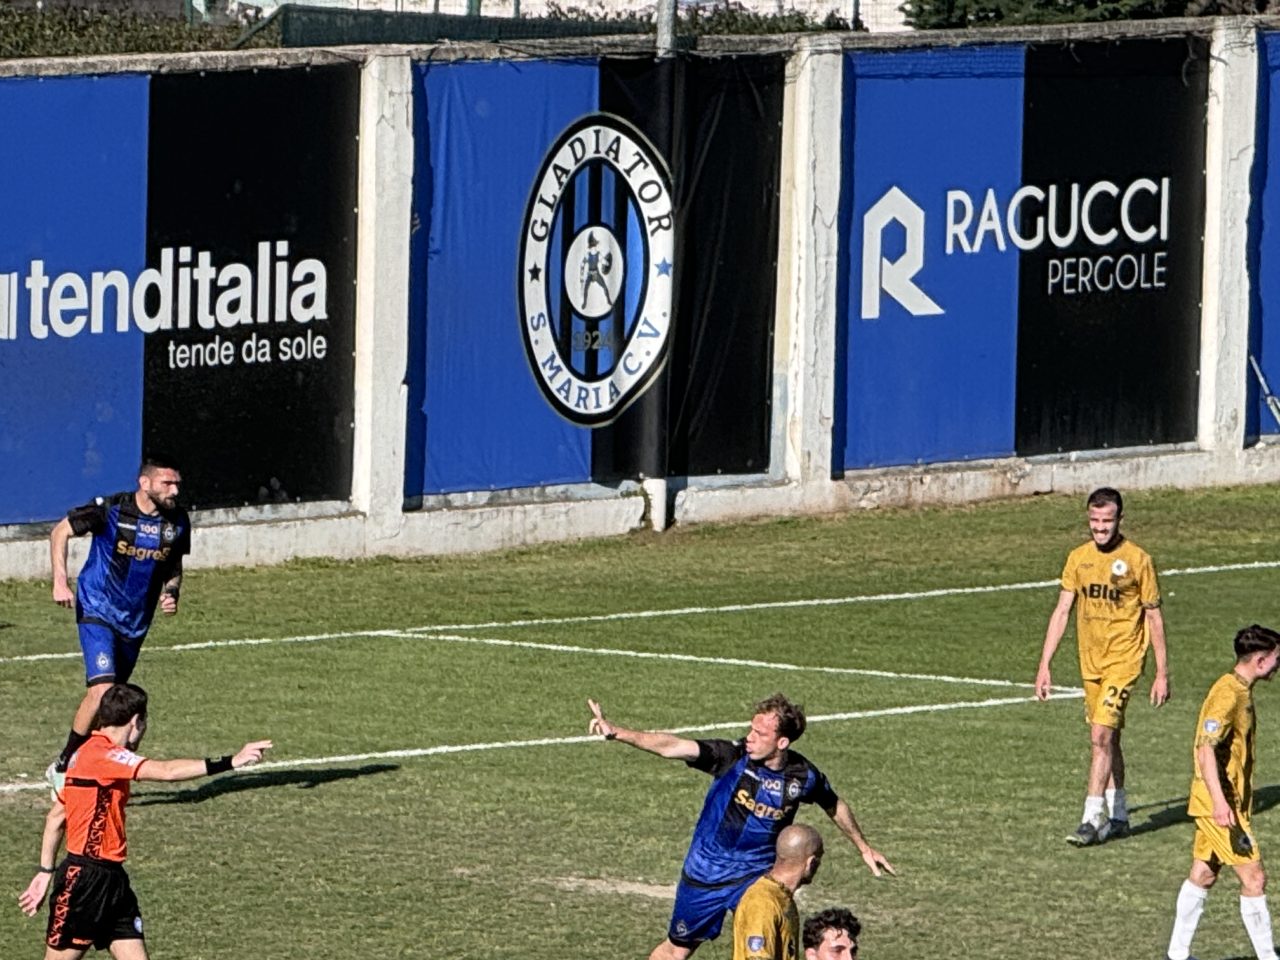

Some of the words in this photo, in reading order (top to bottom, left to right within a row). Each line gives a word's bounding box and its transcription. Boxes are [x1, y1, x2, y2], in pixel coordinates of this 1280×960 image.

[530, 129, 672, 243] GLADIATOR
[945, 177, 1170, 255] RAGUCCI
[25, 240, 328, 340] tenditalia
[1047, 252, 1168, 295] PERGOLE
[168, 335, 235, 369] tende
[241, 333, 271, 364] da
[278, 329, 328, 361] sole
[541, 350, 621, 410] MARIA
